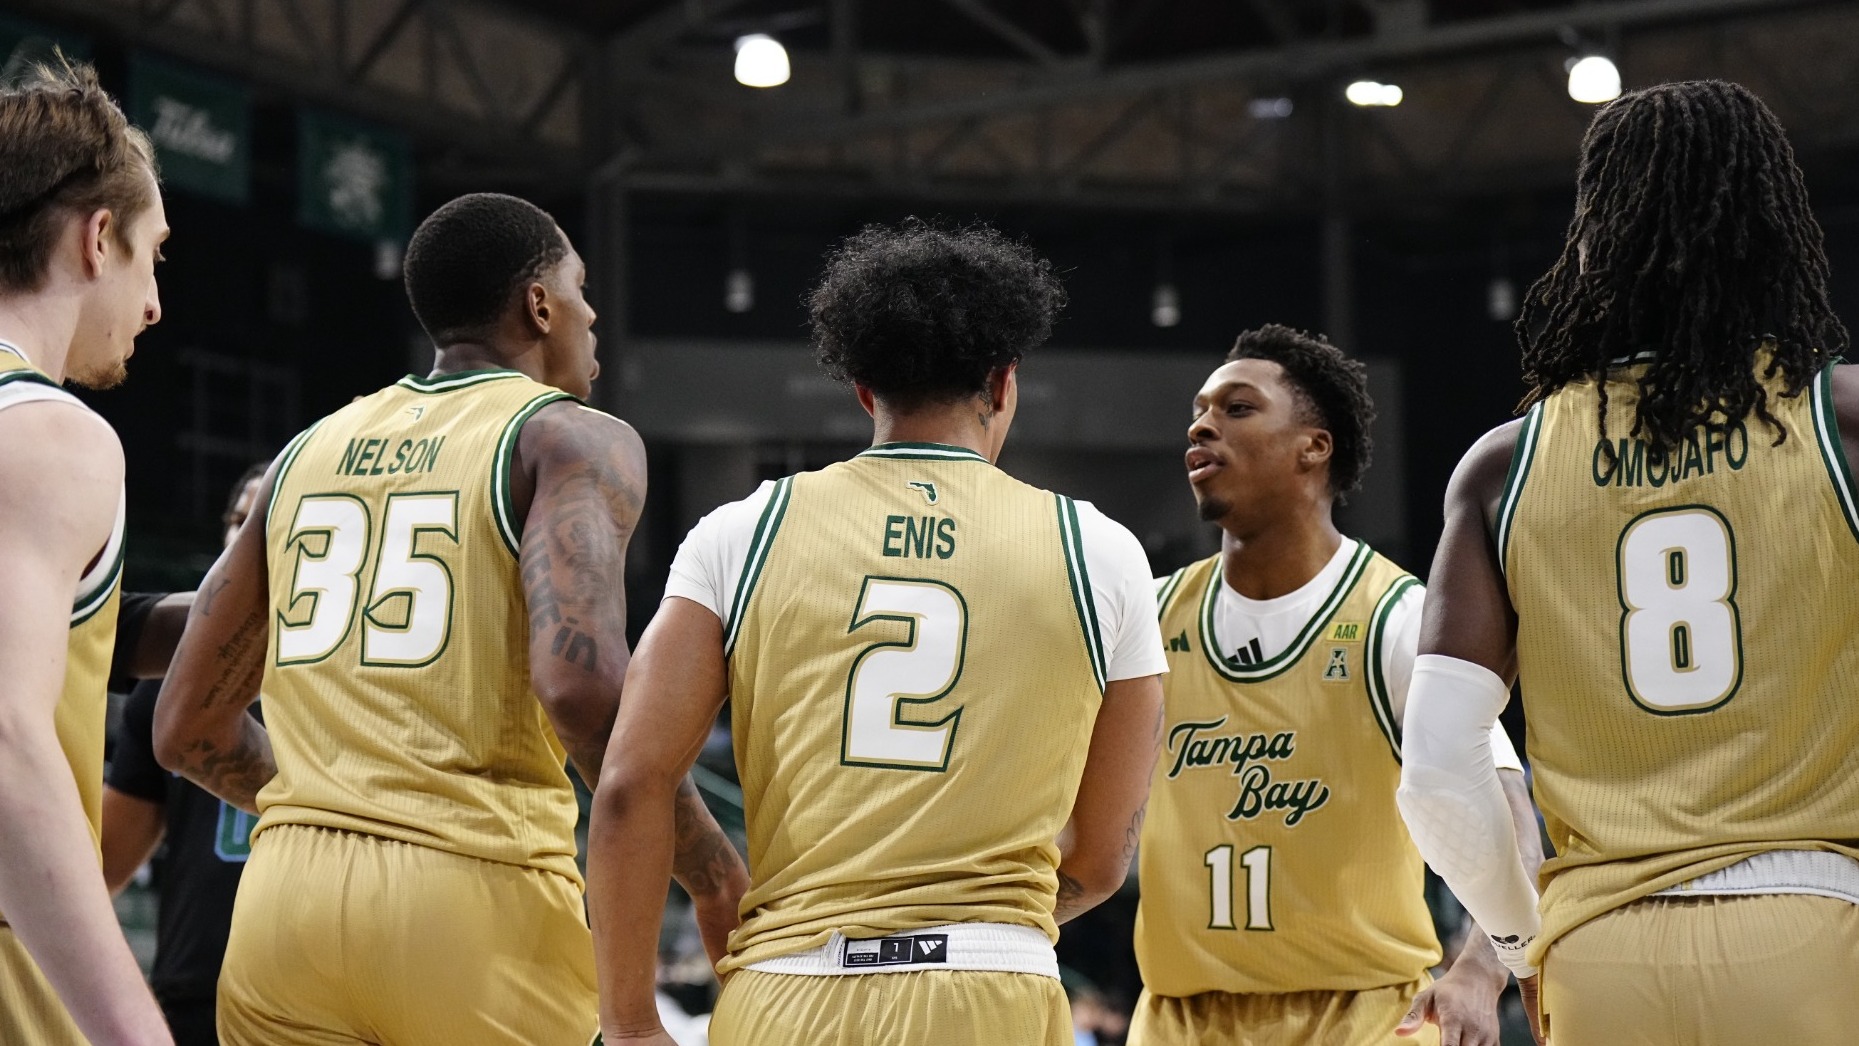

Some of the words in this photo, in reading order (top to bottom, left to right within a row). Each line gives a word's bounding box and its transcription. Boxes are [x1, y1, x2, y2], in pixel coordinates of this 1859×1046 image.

[335, 435, 446, 476] NELSON
[1592, 420, 1748, 488] OMOJAFO
[882, 514, 956, 560] ENIS
[276, 490, 460, 667] 35
[1615, 503, 1744, 716] 8
[1333, 624, 1358, 640] AAR
[840, 575, 969, 773] 2
[1167, 714, 1297, 780] Tampa
[1225, 764, 1330, 827] Bay
[1204, 844, 1275, 932] 11
